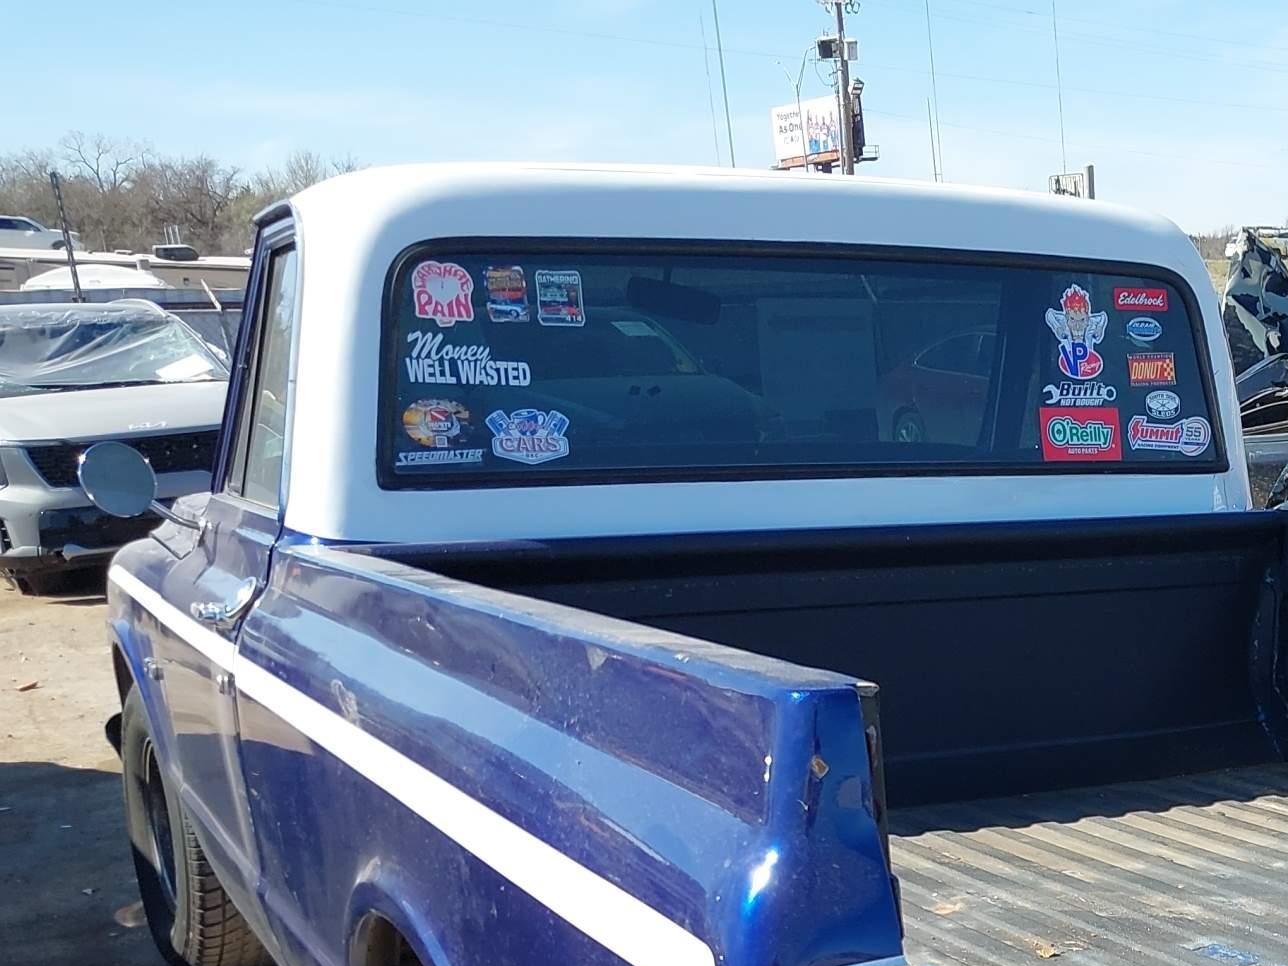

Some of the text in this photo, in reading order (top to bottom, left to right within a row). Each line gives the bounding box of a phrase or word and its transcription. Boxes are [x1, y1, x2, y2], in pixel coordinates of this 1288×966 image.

[416, 289, 472, 319] PAIN
[1118, 291, 1165, 306] Edelbrock
[407, 330, 492, 367] Money
[1060, 342, 1089, 377] VP
[405, 357, 532, 387] WELL WASTED
[1132, 361, 1163, 380] DONUT
[1059, 382, 1105, 397] Built
[502, 435, 560, 453] CARS
[1050, 420, 1110, 446] O'Reilly
[395, 448, 485, 466] SPEEDMASTER
